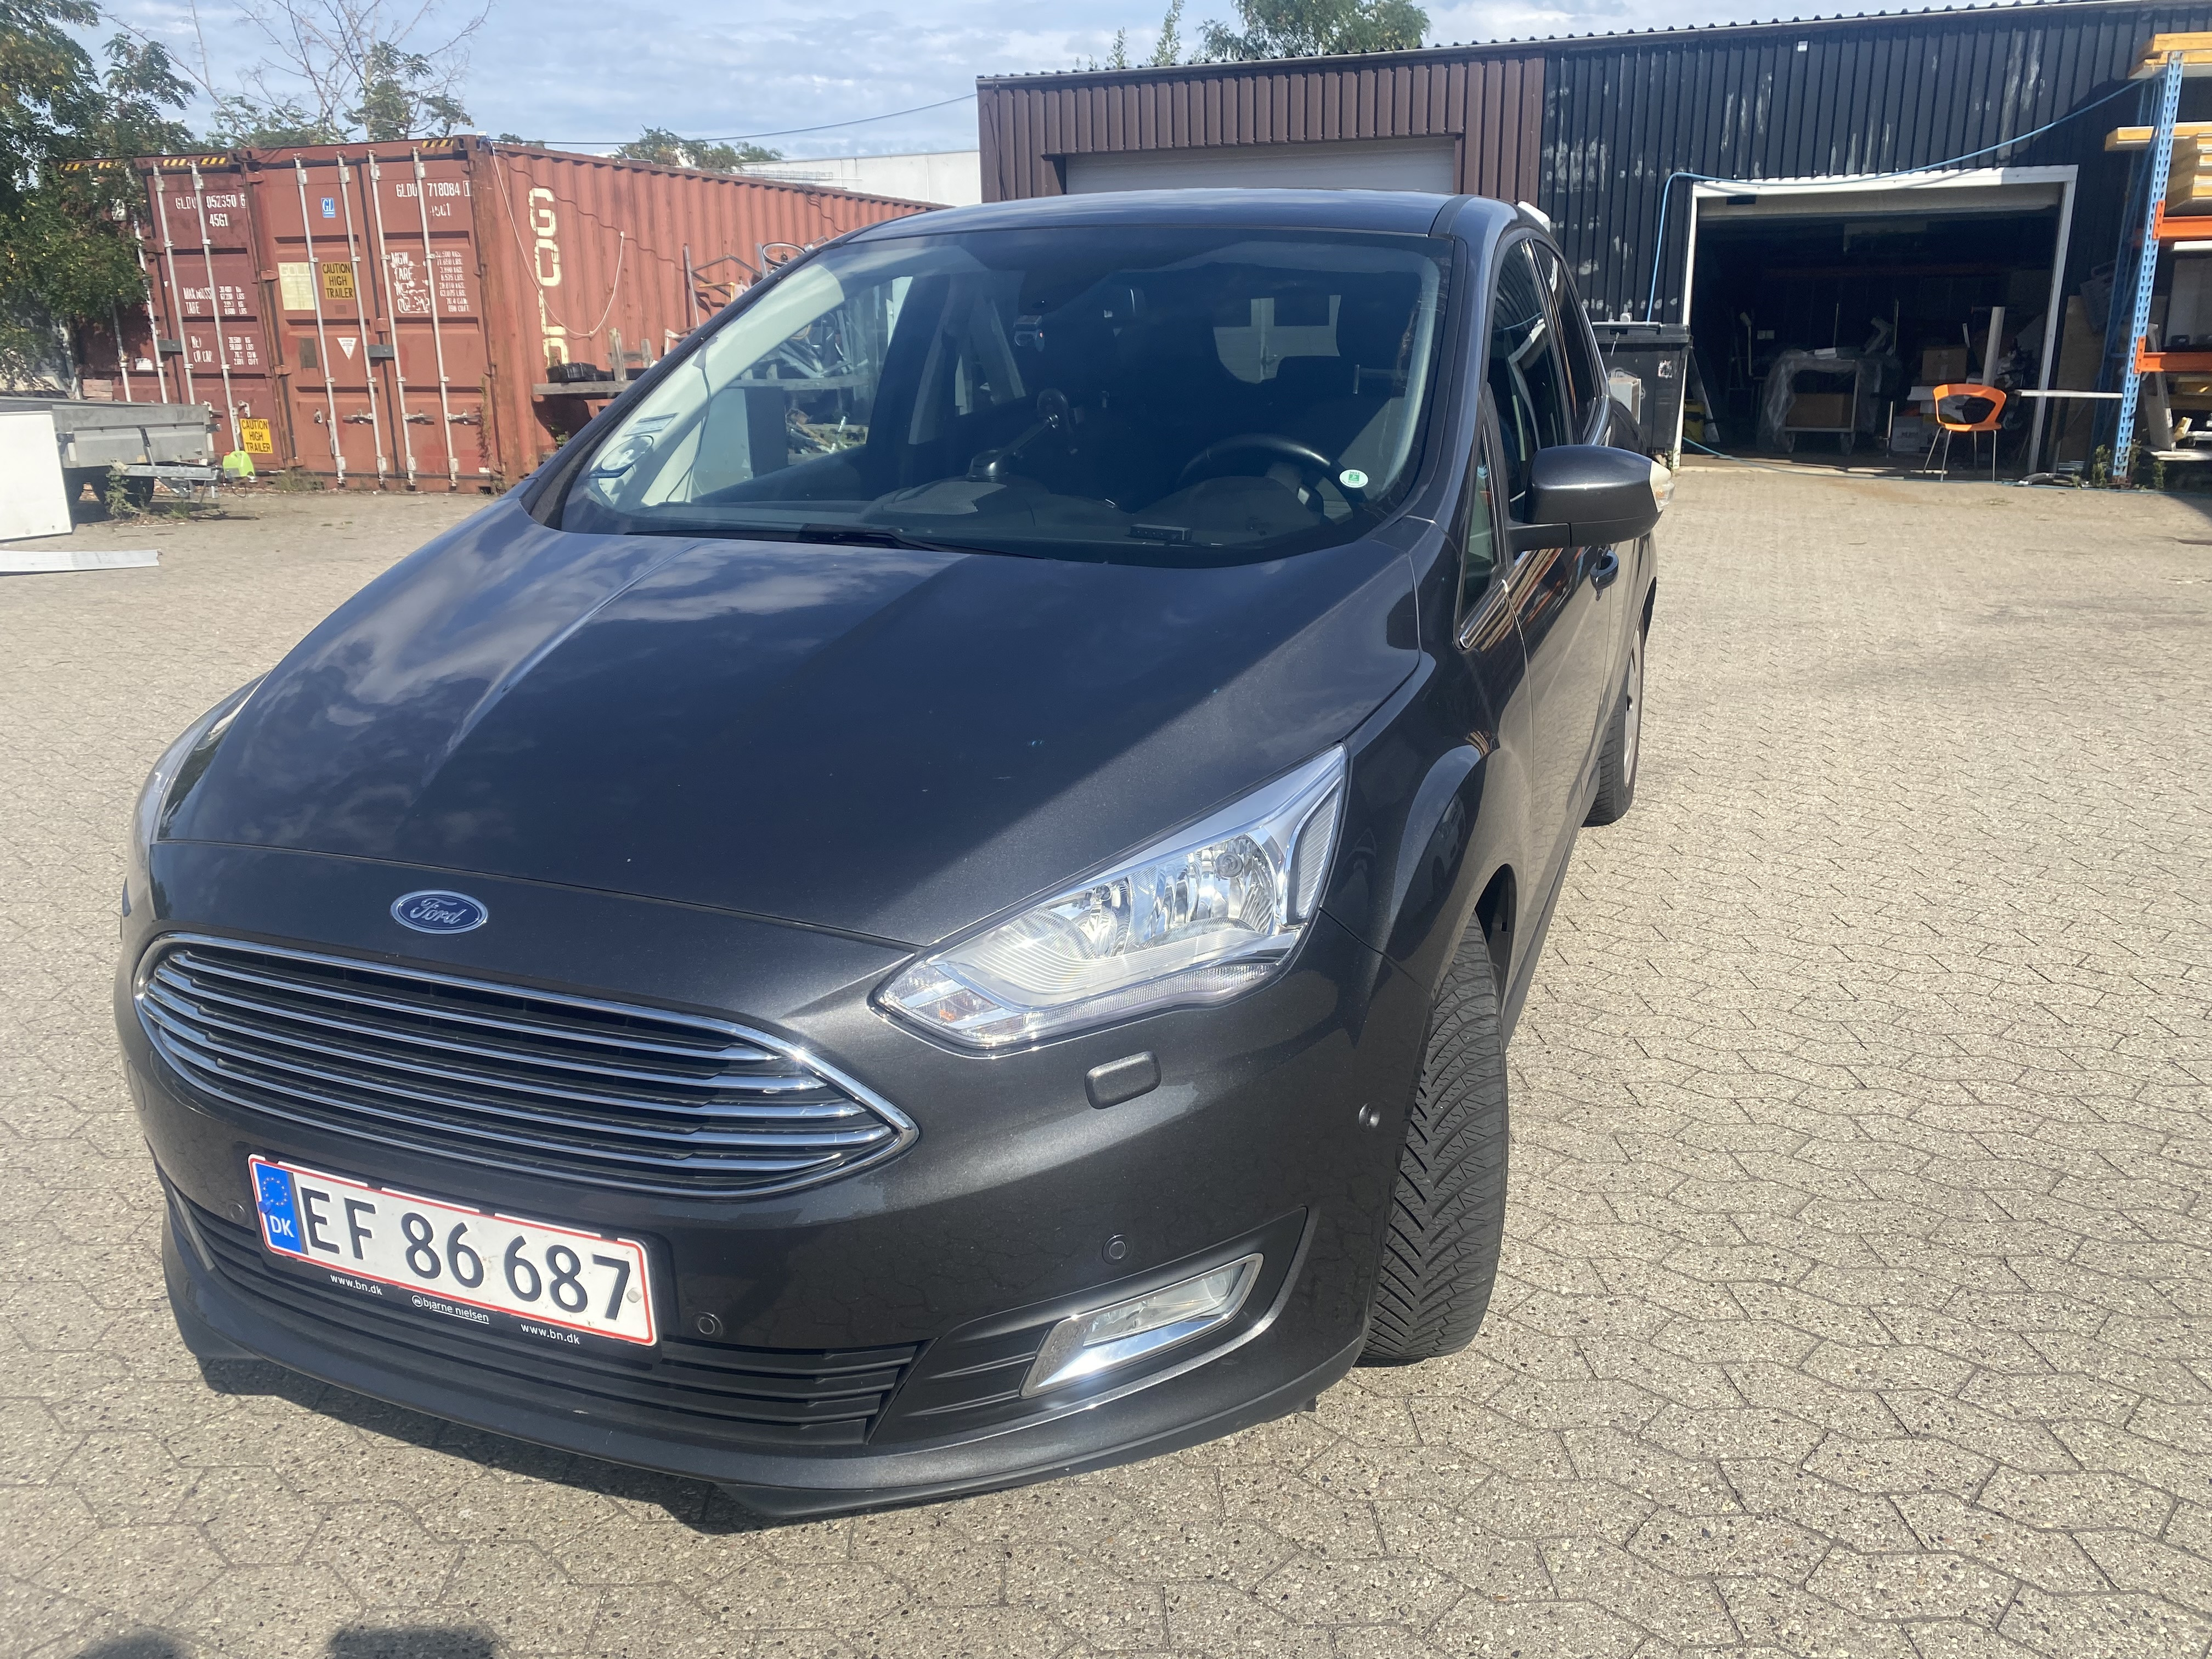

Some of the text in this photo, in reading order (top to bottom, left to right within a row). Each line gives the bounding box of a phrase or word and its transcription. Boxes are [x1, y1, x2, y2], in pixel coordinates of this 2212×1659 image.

[396, 183, 418, 198] GLDU
[427, 182, 460, 197] 718084
[175, 196, 198, 209] GLDU
[206, 194, 237, 208] 052350
[322, 199, 334, 212] GL
[210, 213, 228, 227] 45G1
[391, 251, 408, 266] MGW
[322, 263, 351, 274] CAUTION
[329, 275, 347, 286] HIGH
[325, 287, 354, 298] TRAILER
[185, 301, 201, 314] TARE
[241, 420, 268, 430] CAUTION
[249, 431, 264, 442] HIGH
[246, 442, 271, 453] TRAILER
[409, 898, 467, 924] Ford
[269, 1215, 295, 1238] DK
[300, 1186, 631, 1322] EF 86 687
[330, 1273, 383, 1296] www.bn.dk
[422, 1296, 489, 1323] bjarne nielsen
[520, 1322, 581, 1345] www.bn.dk
